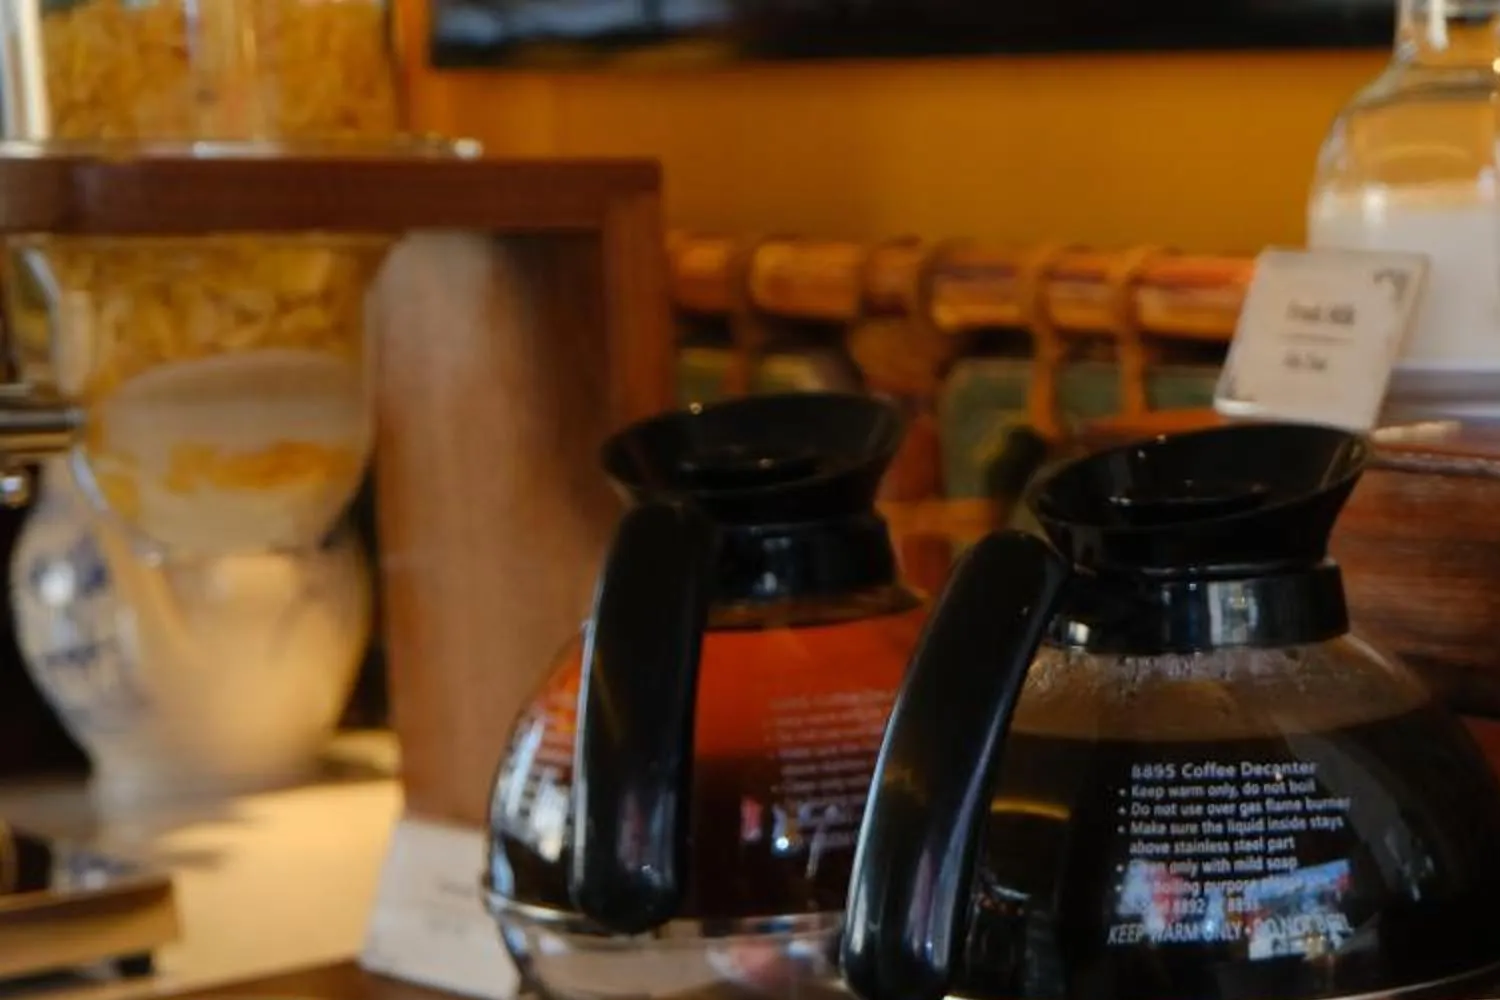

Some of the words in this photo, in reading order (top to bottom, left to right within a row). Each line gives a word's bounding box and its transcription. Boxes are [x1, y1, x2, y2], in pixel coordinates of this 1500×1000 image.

[1181, 761, 1236, 779] Coffee
[1240, 761, 1318, 778] Decanter
[1130, 784, 1165, 800] Keep
[1167, 784, 1206, 798] warm
[1242, 781, 1261, 795] do
[1263, 780, 1287, 795] not
[1288, 778, 1317, 794] boil
[1130, 801, 1150, 817] Do
[1153, 803, 1178, 817] not
[1180, 803, 1204, 817] use
[1206, 802, 1236, 816] over
[1239, 802, 1263, 818] gas
[1265, 797, 1303, 813] flame
[1129, 820, 1167, 835] Make
[1169, 821, 1199, 835] sure
[1201, 819, 1224, 834] the
[1226, 817, 1265, 835] liquid
[1266, 815, 1307, 832] inside
[1309, 815, 1344, 832] stays
[1129, 840, 1170, 855] above
[1173, 838, 1231, 855] stainless
[1232, 836, 1264, 854] steel
[1266, 836, 1296, 854] part
[1169, 859, 1199, 878] only
[1201, 857, 1231, 874] with
[1233, 855, 1264, 871] mild
[1266, 856, 1298, 873] soap
[1107, 923, 1146, 945] KEEP
[1151, 920, 1202, 943] WARM
